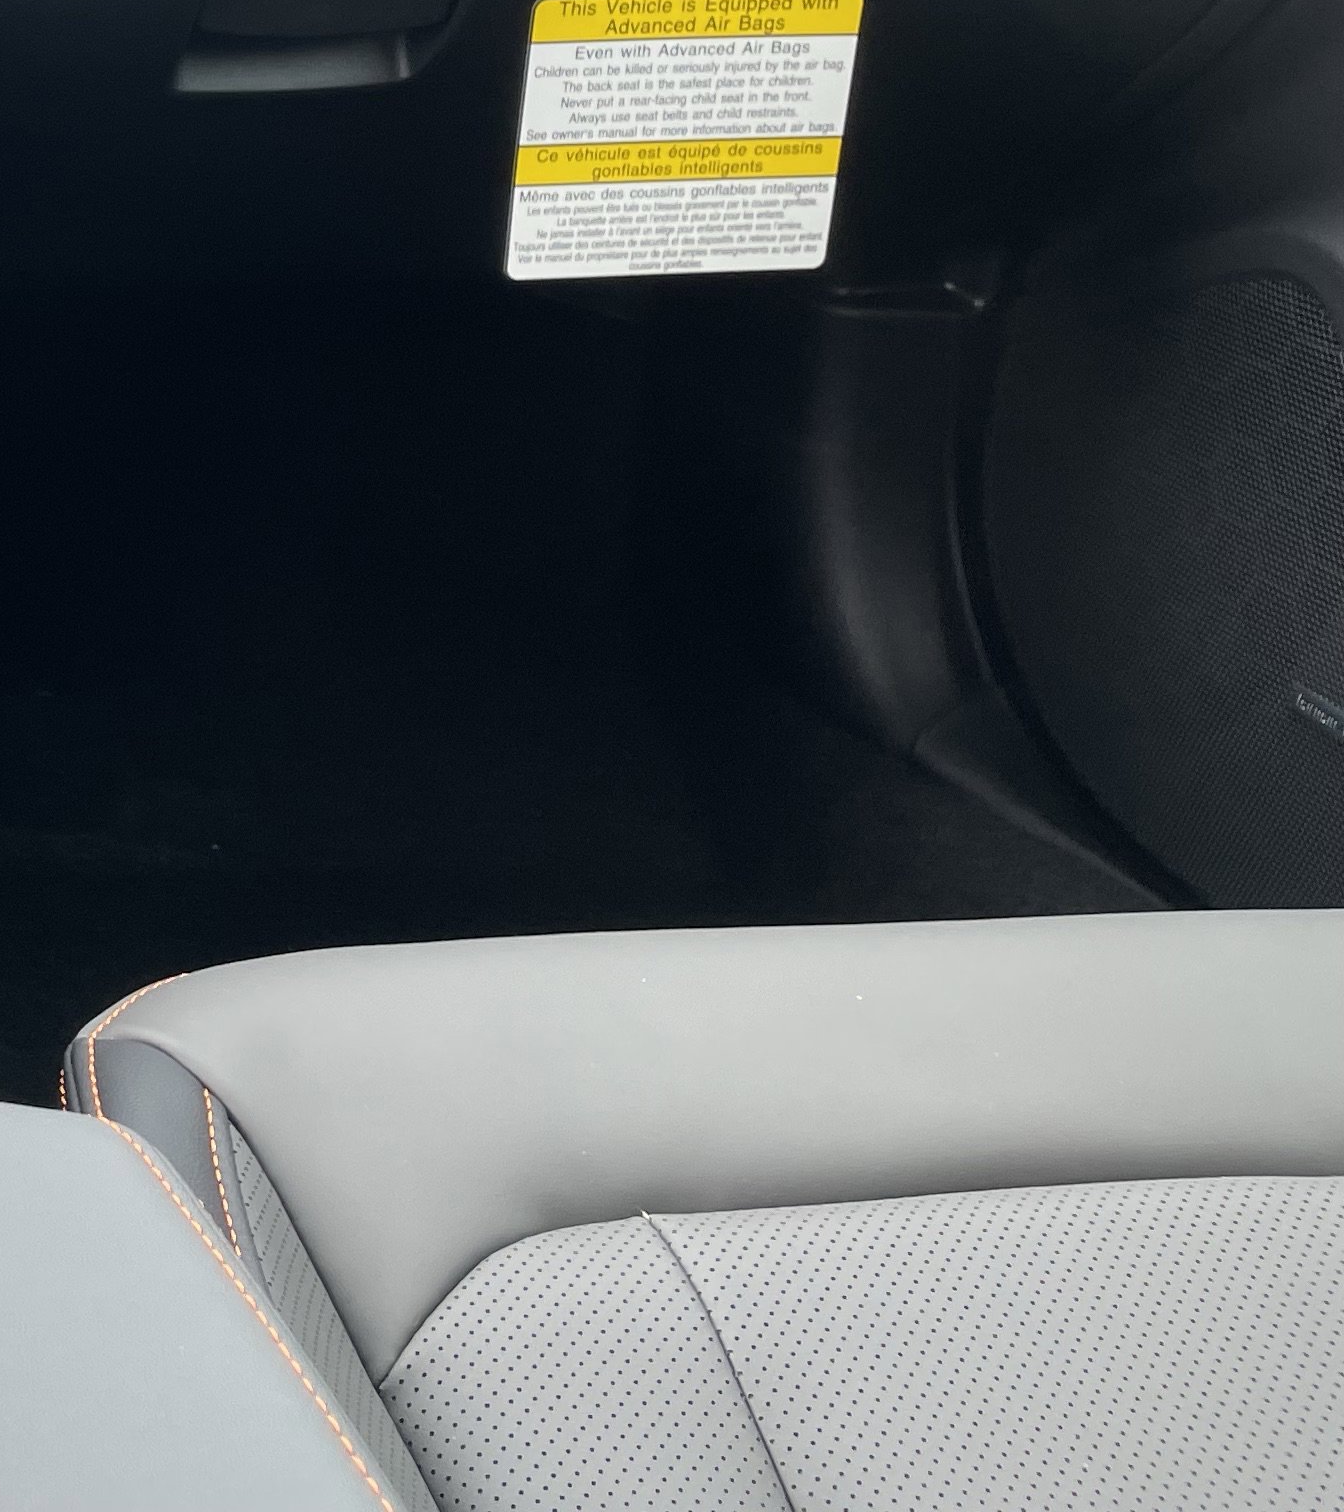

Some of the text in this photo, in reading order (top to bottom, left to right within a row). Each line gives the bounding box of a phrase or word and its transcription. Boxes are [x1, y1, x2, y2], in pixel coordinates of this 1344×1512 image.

[560, 0, 596, 16] This
[604, 14, 785, 35] Advanced Air Bags
[575, 40, 810, 60] Even with Advanced Air Bags
